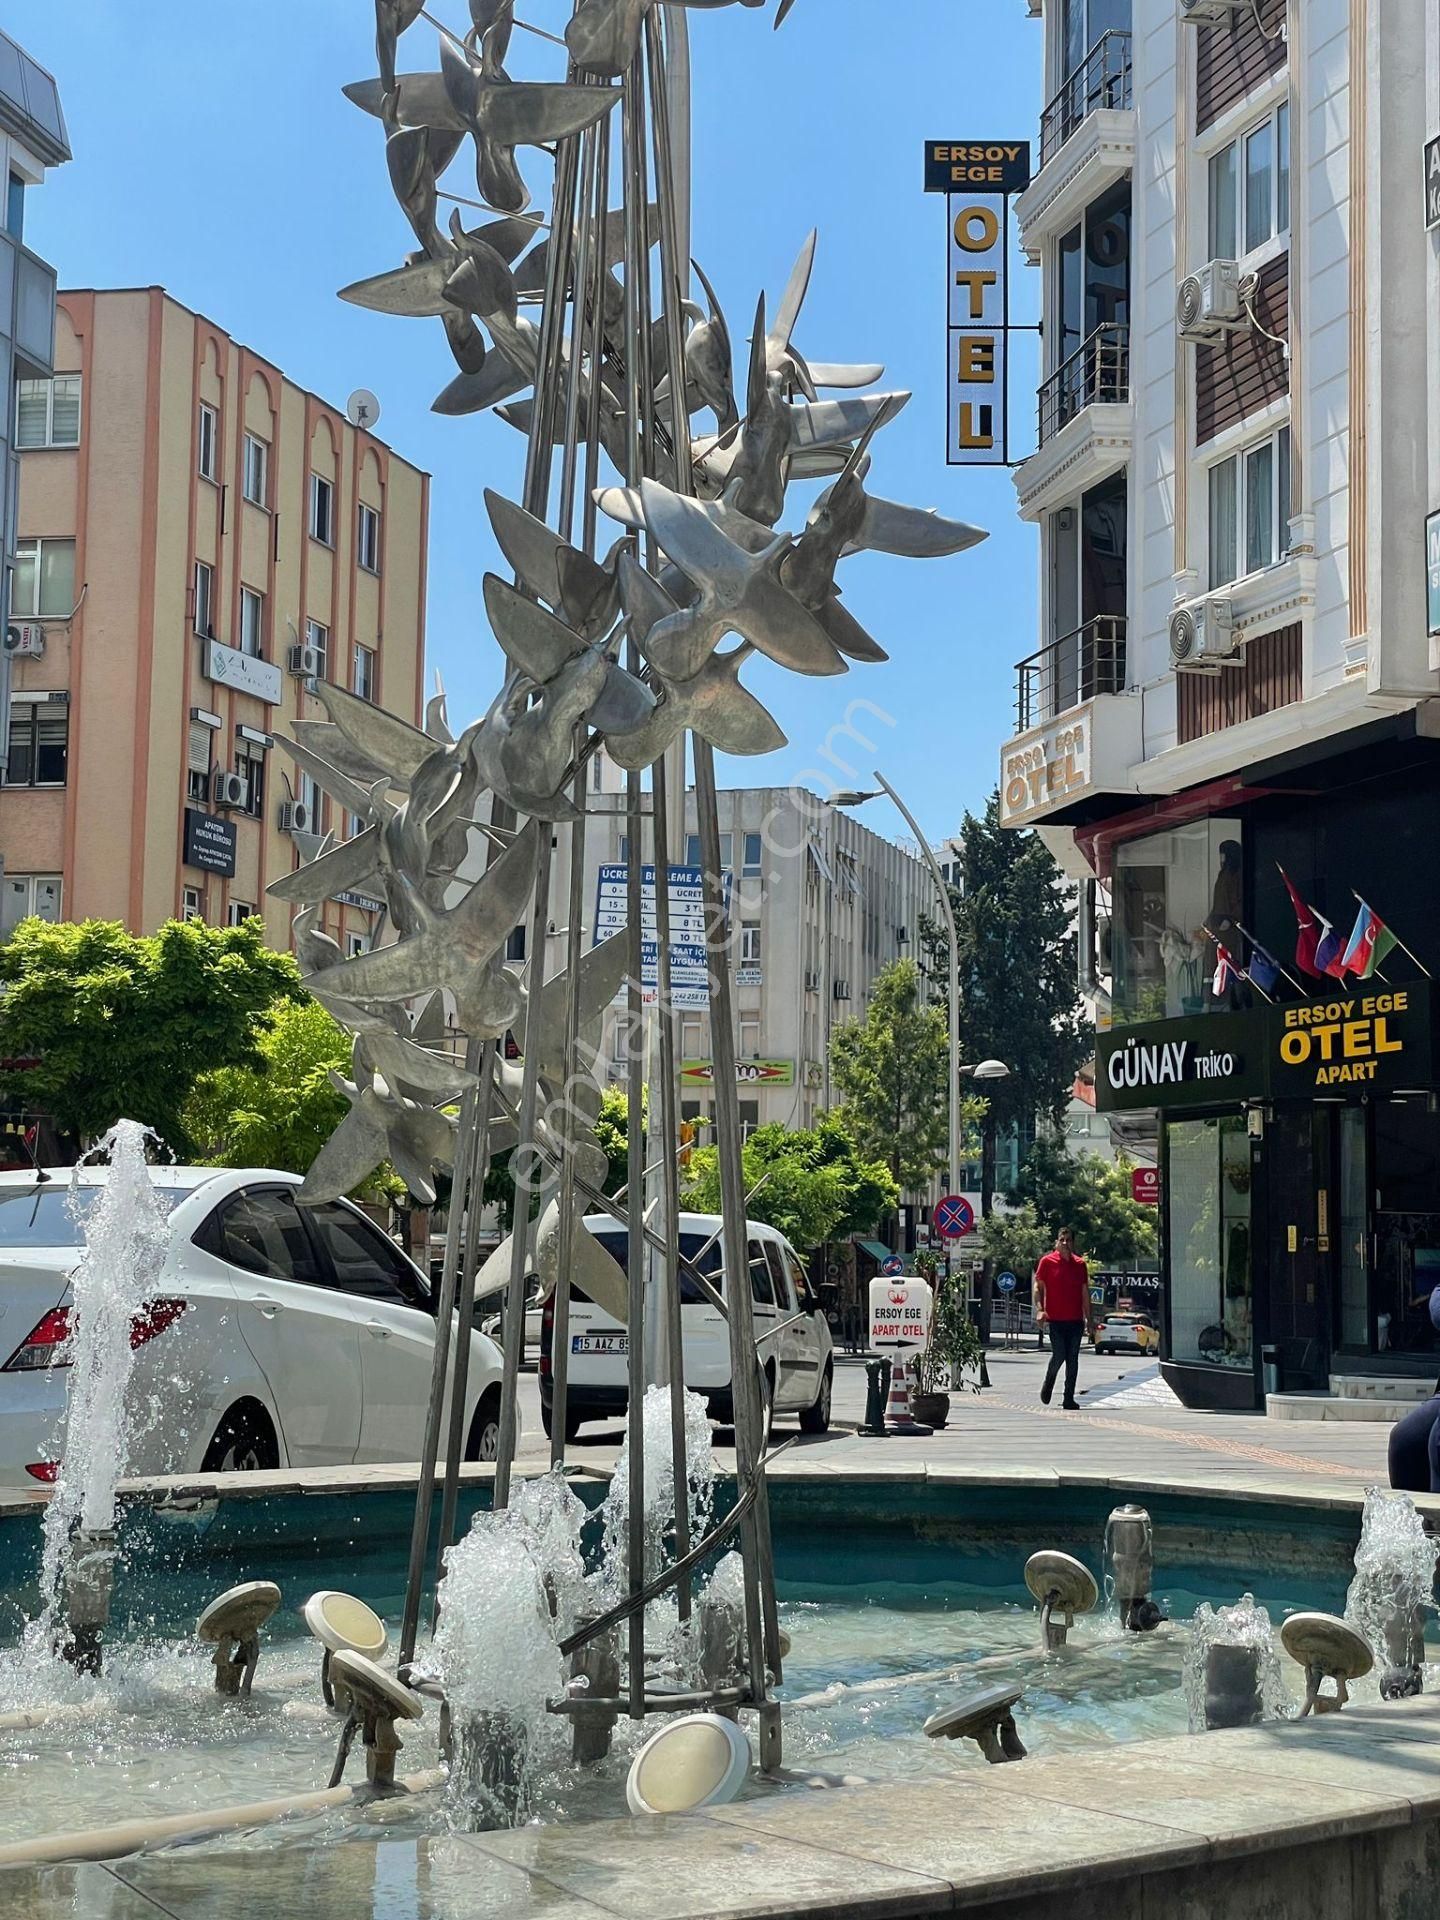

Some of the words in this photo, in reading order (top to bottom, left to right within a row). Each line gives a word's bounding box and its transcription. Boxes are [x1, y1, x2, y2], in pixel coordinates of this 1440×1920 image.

[933, 146, 1022, 162] ERSOY
[951, 166, 1003, 182] EGE
[954, 206, 998, 449] OTEL
[1007, 741, 1049, 774] ERSOY
[1056, 725, 1083, 752] EGE
[1006, 753, 1084, 809] OTEL
[677, 889, 702, 897] ÜCRET
[1284, 1000, 1355, 1028] ERSOY
[1362, 991, 1408, 1016] EGE
[1279, 1016, 1403, 1065] OTEL
[1108, 1037, 1187, 1089] GÜNAY
[1194, 1050, 1233, 1080] TRİKO
[1315, 1060, 1378, 1085] APART
[875, 1308, 902, 1319] ERSOY
[904, 1308, 921, 1319] EGE
[872, 1325, 901, 1336] APART
[902, 1325, 924, 1336] OTEL
[595, 1338, 614, 1349] AAZ
